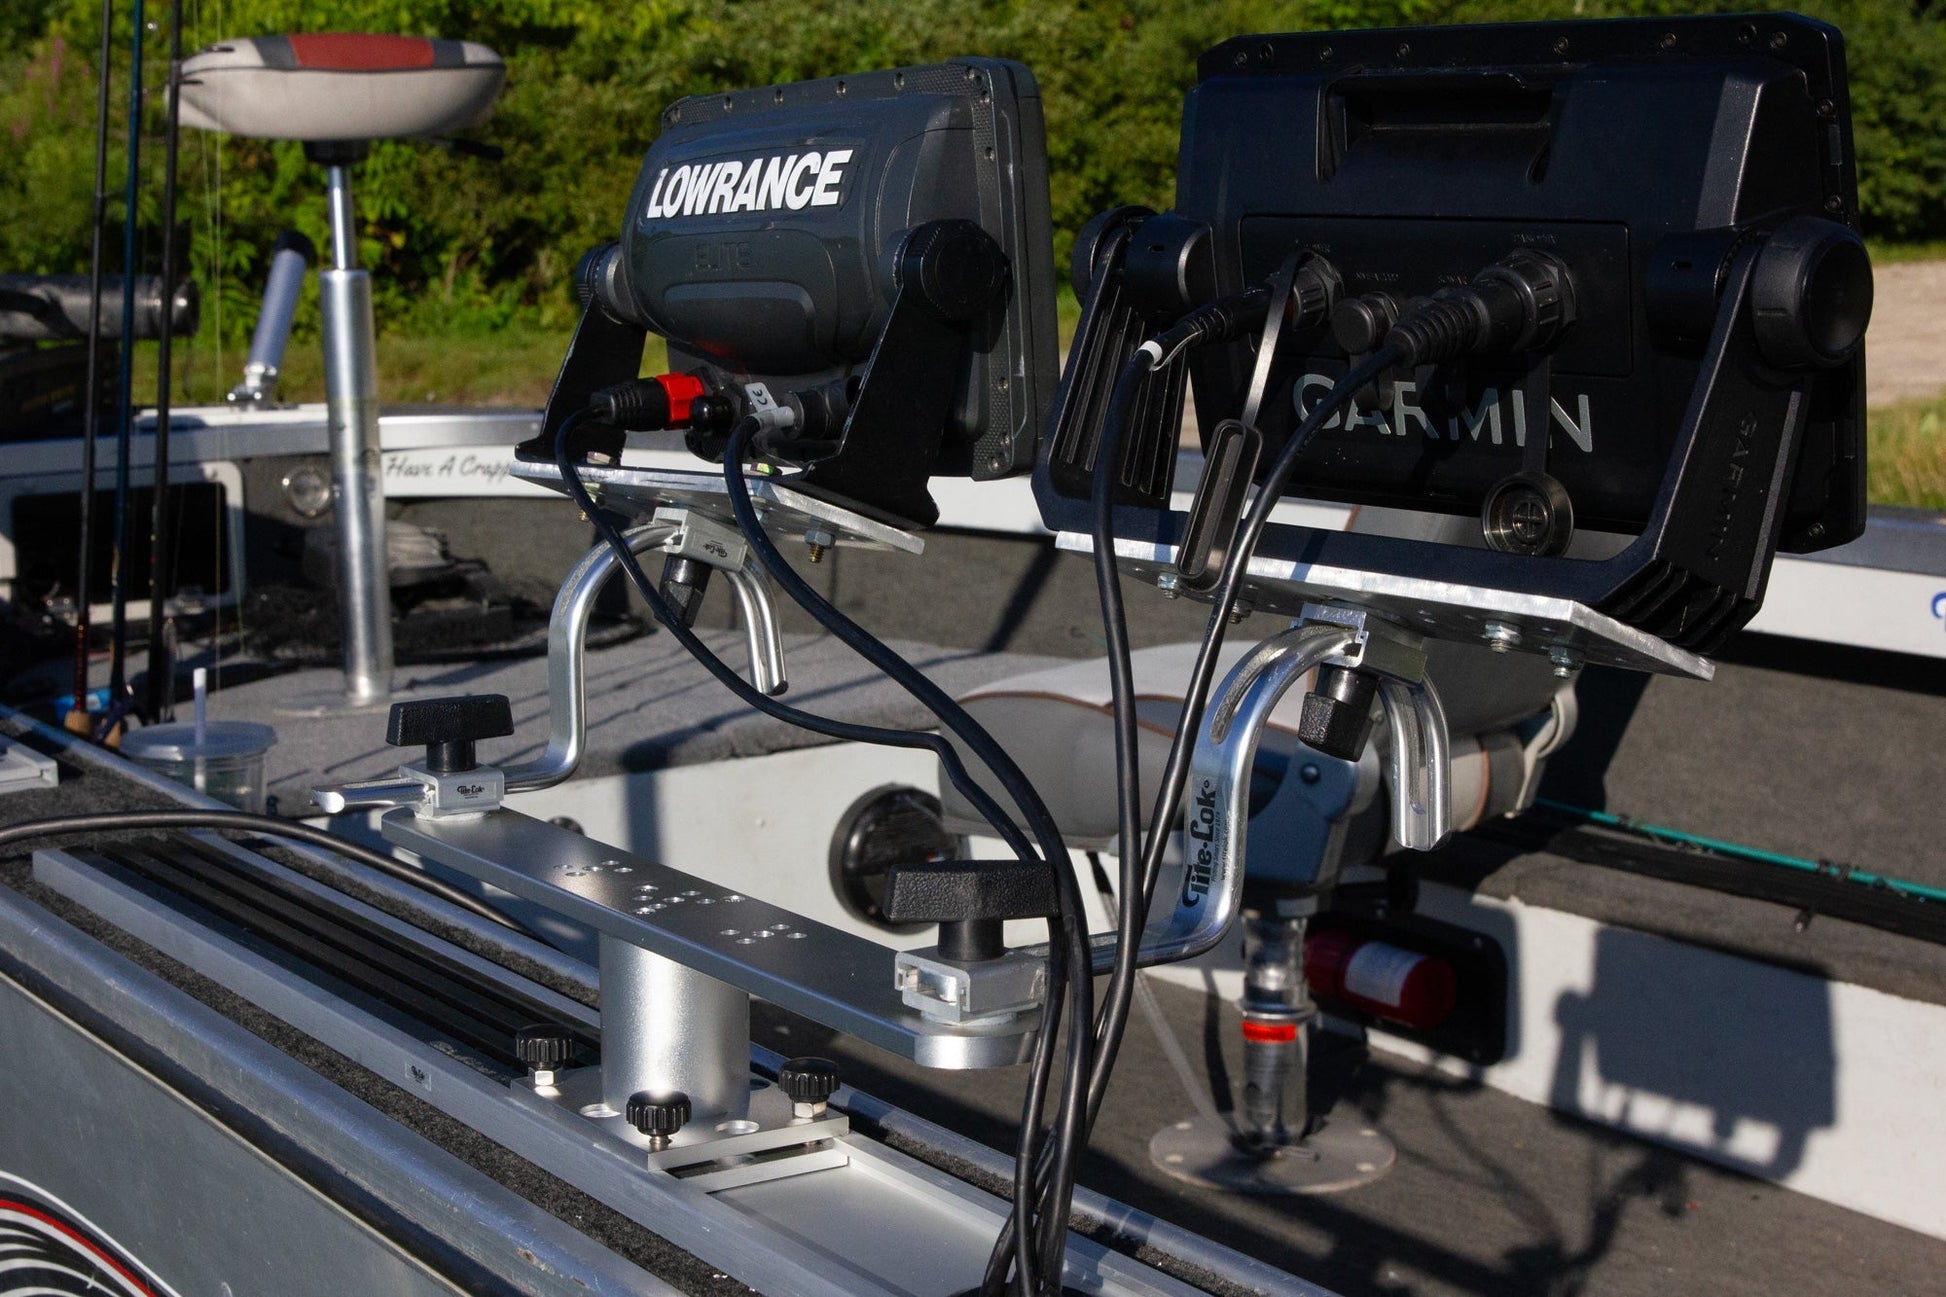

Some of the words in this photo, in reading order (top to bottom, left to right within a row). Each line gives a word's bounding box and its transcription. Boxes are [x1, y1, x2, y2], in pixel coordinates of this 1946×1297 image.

[647, 149, 854, 219] LOWRANCE
[695, 241, 753, 270] ELITE
[752, 389, 768, 406] CE
[386, 455, 433, 477] Have
[439, 454, 457, 476] A
